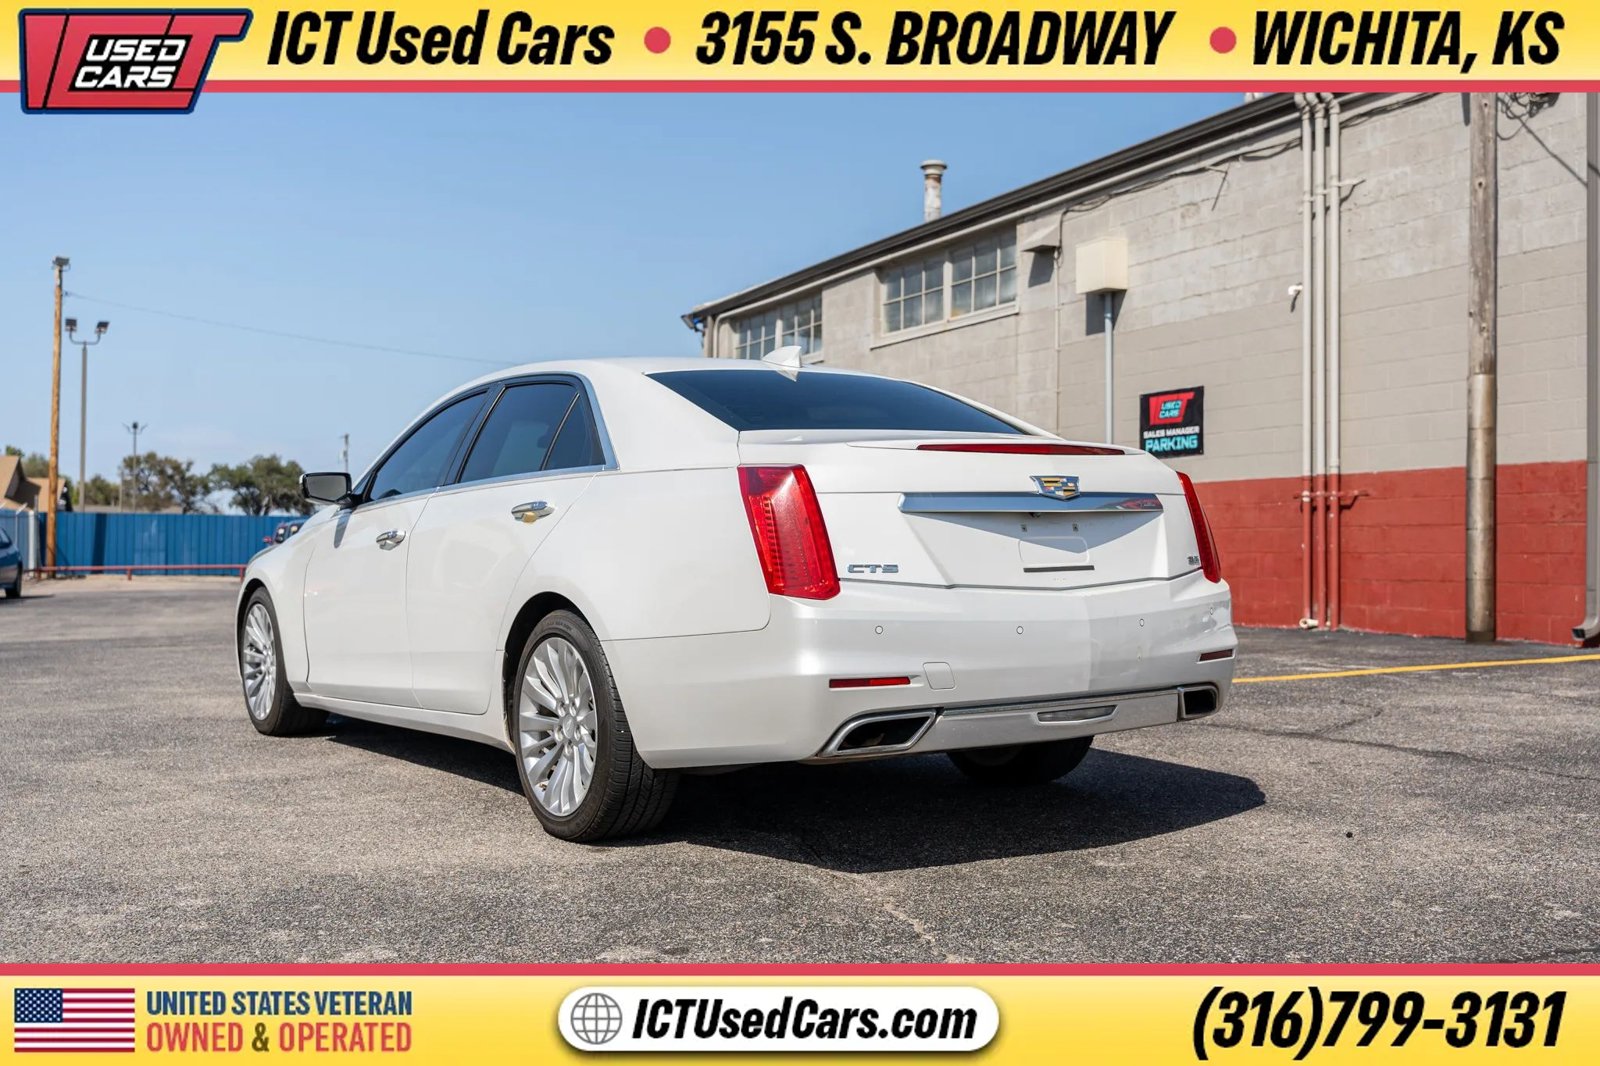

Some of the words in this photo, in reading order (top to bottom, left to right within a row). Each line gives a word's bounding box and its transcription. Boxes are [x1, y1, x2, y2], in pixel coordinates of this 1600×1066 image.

[1143, 429, 1166, 439] SALES
[1166, 426, 1200, 436] MANAGER
[1145, 435, 1198, 452] PARKING
[847, 564, 899, 573] CTS
